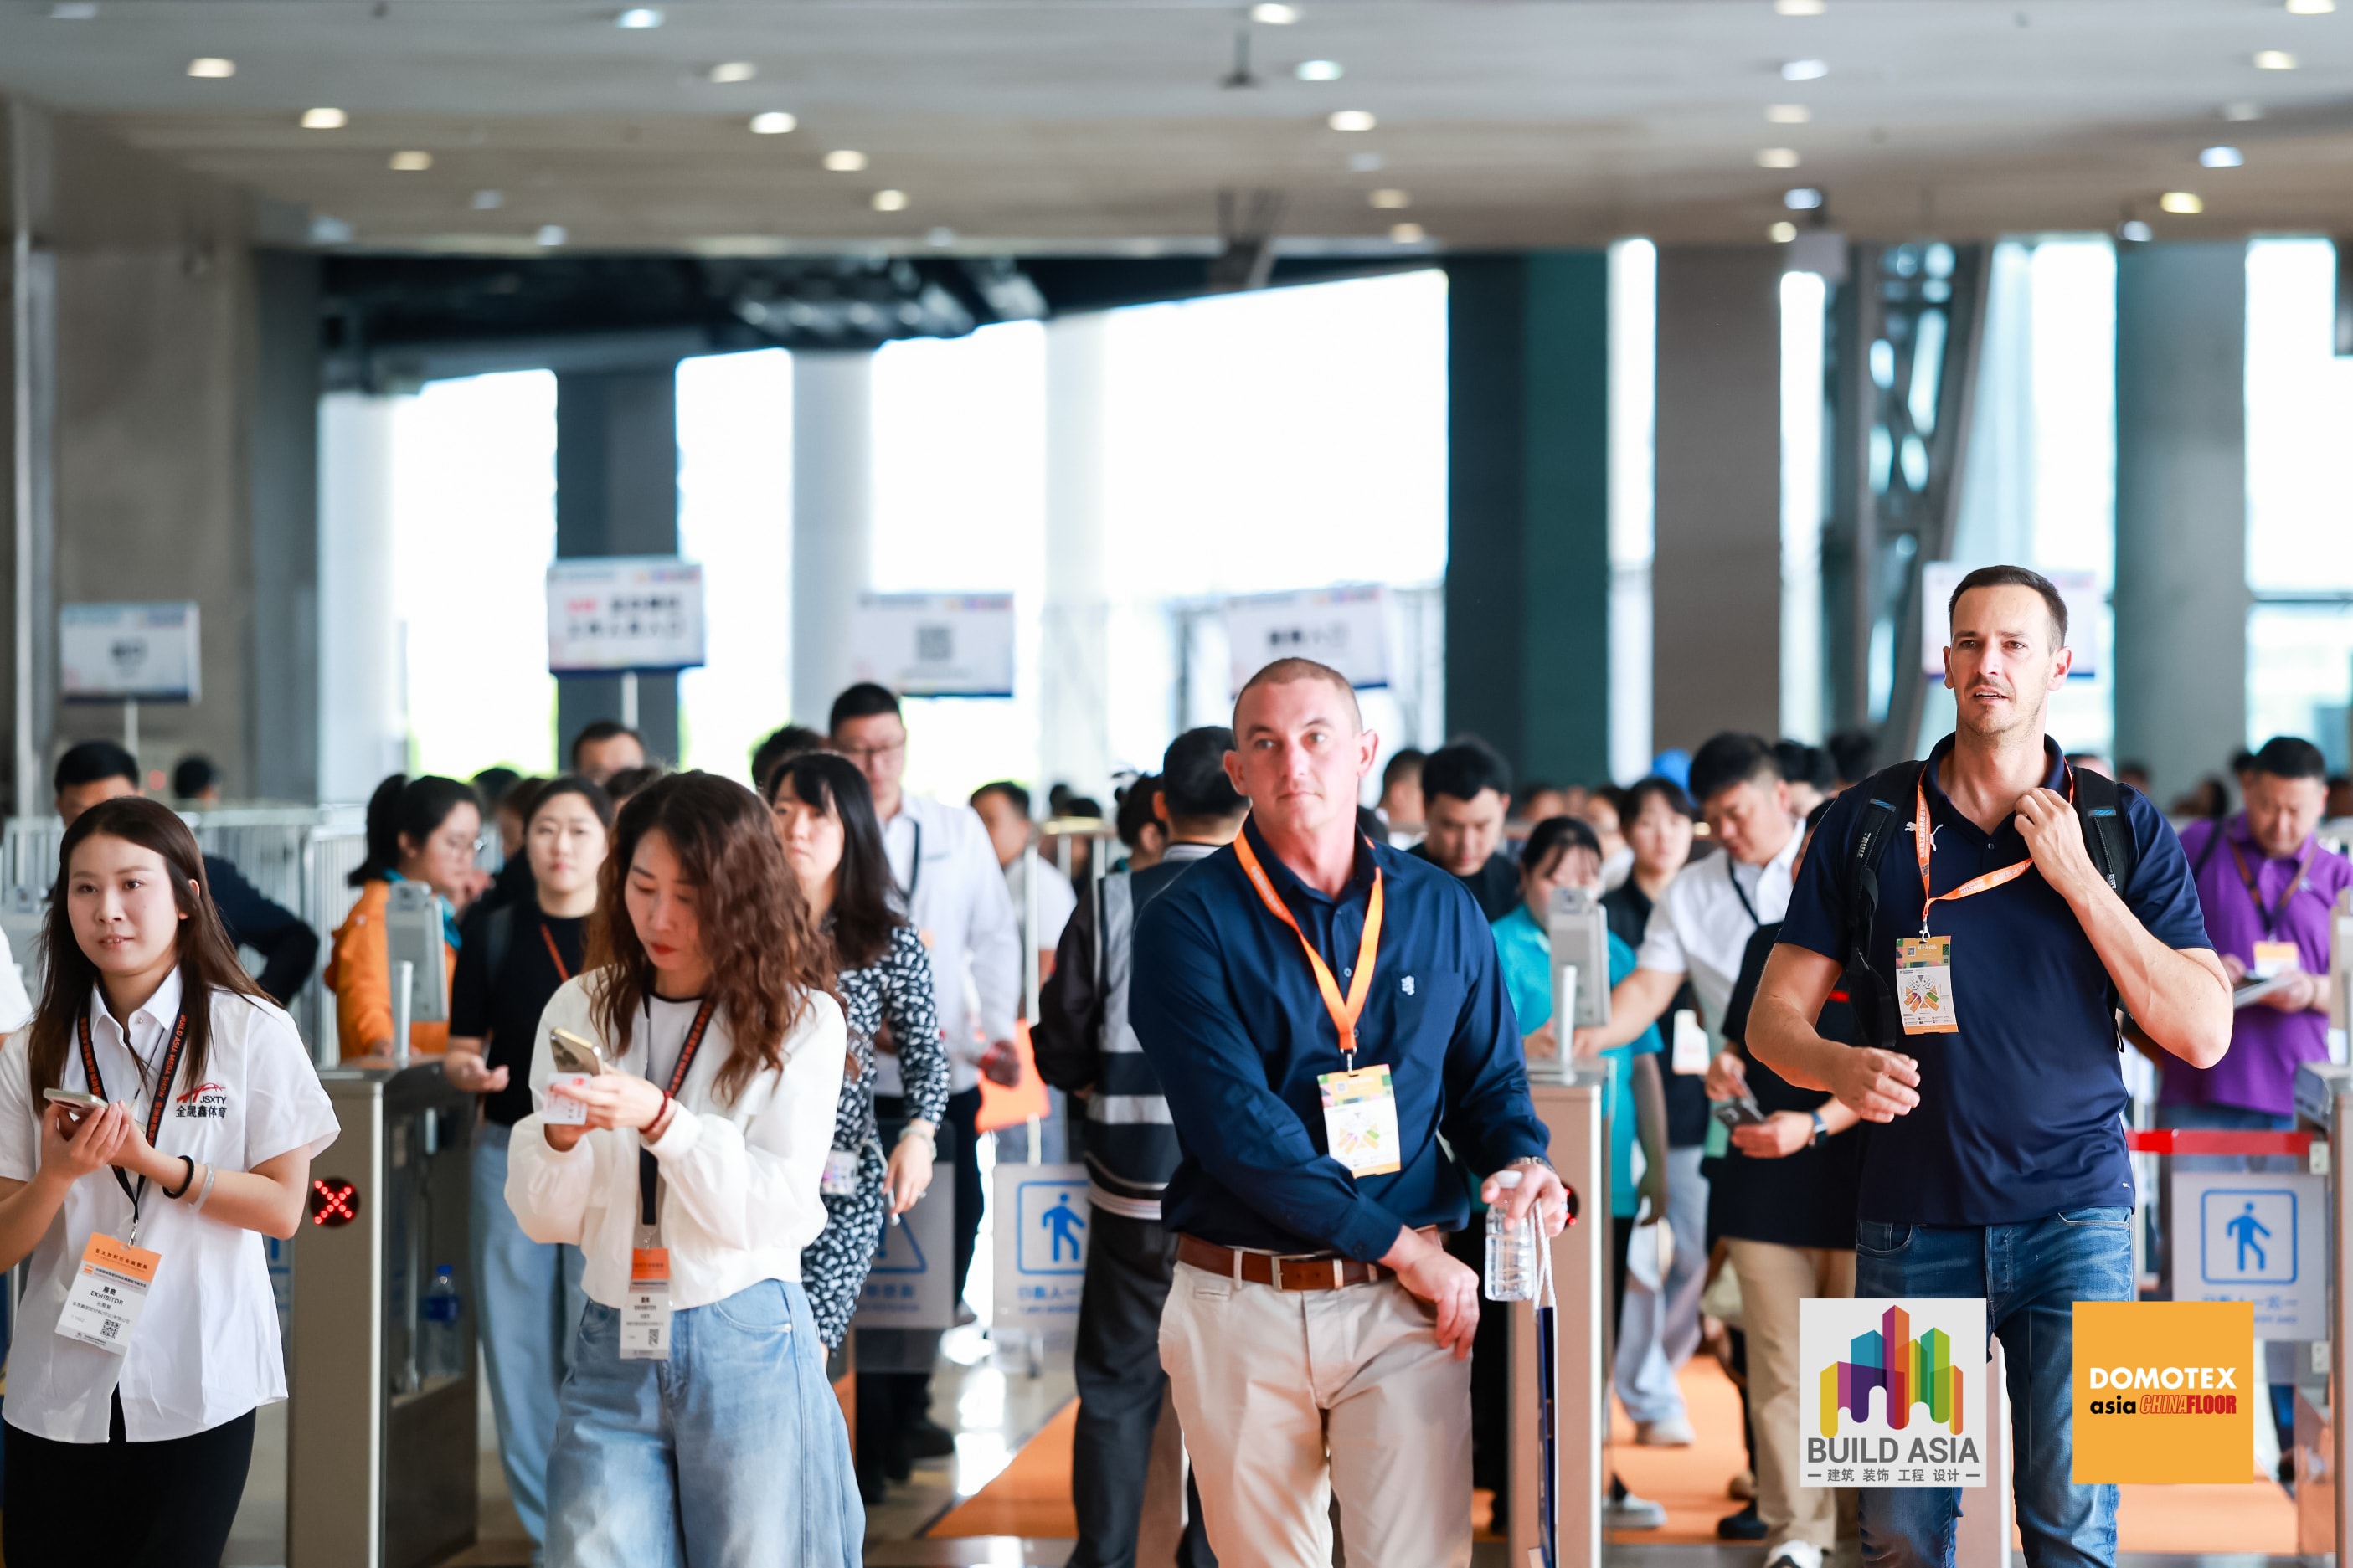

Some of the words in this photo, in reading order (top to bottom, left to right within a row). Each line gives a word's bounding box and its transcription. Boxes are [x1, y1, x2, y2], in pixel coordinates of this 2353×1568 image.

[176, 1014, 188, 1036] BUILD
[170, 1036, 182, 1052] ASIA
[165, 1054, 176, 1073] MEGA
[158, 1073, 170, 1098] SHOW
[200, 1095, 227, 1104] JSXTY
[176, 1105, 227, 1119] 金晟鑫体育
[90, 1290, 123, 1305] EXHIBITOR
[102, 1286, 117, 1296] 展商
